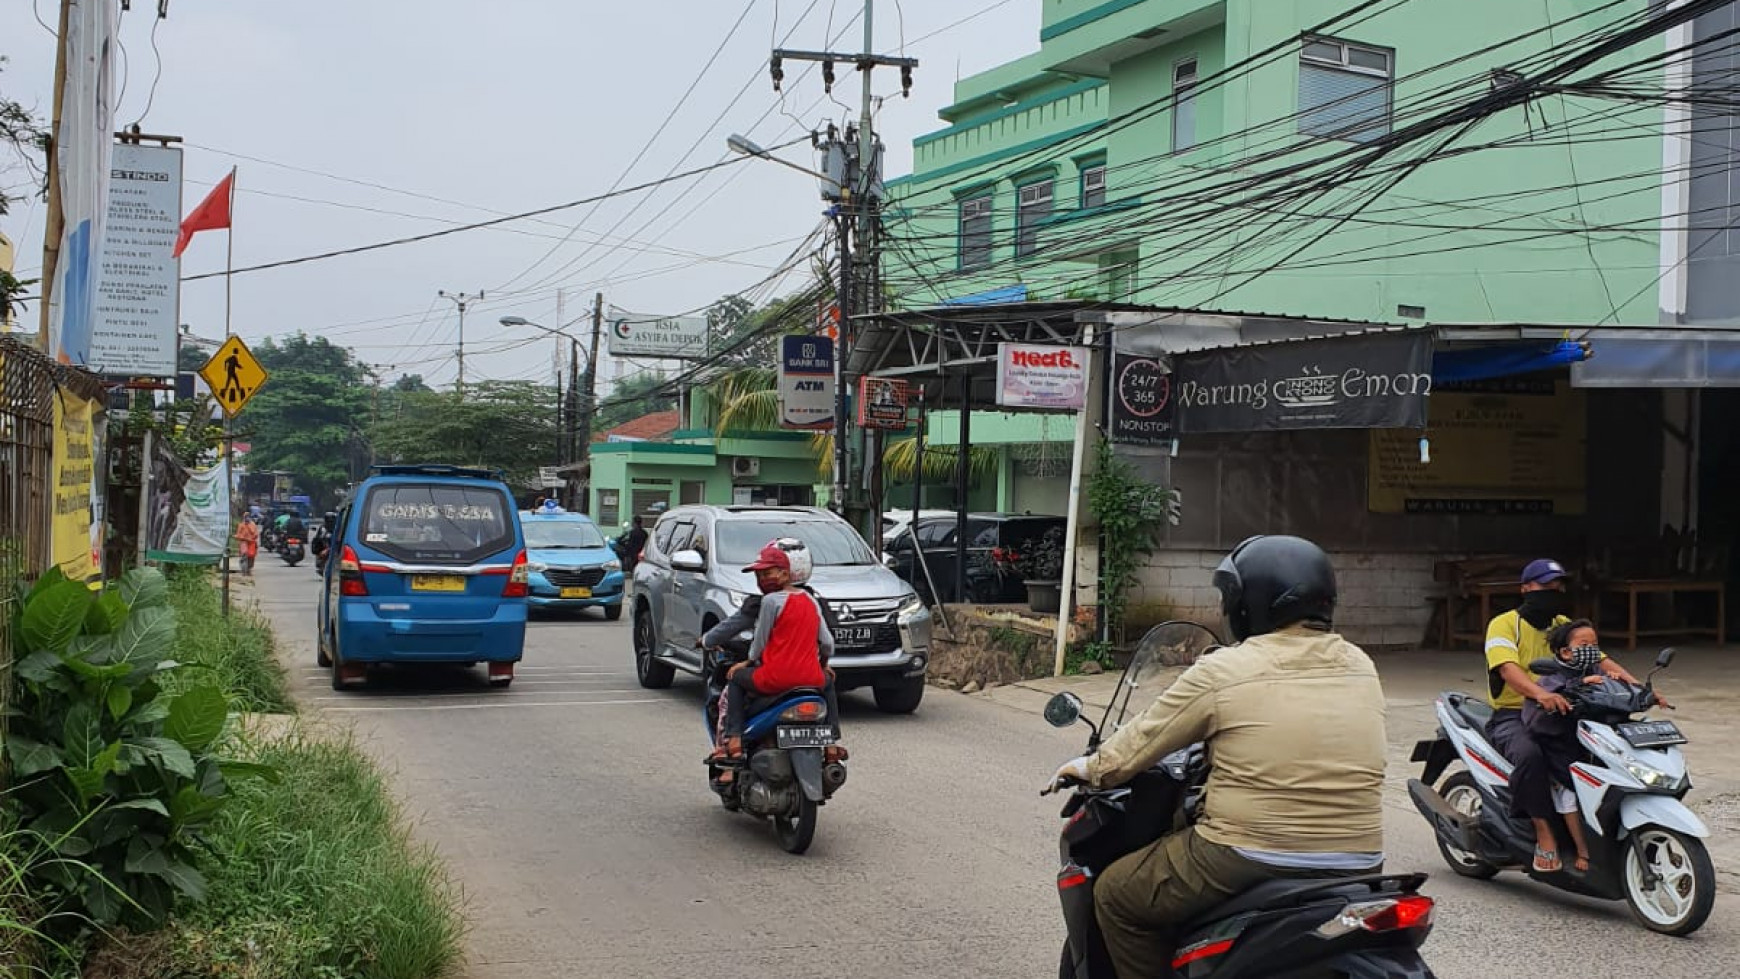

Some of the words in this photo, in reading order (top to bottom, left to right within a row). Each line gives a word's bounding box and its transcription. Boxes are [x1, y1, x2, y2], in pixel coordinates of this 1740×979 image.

[634, 331, 668, 343] ASYIFA
[789, 358, 815, 368] BANK
[794, 380, 825, 392] ATM
[1130, 374, 1159, 388] 24/7
[1134, 391, 1155, 404] 365
[1177, 378, 1268, 410] Warung
